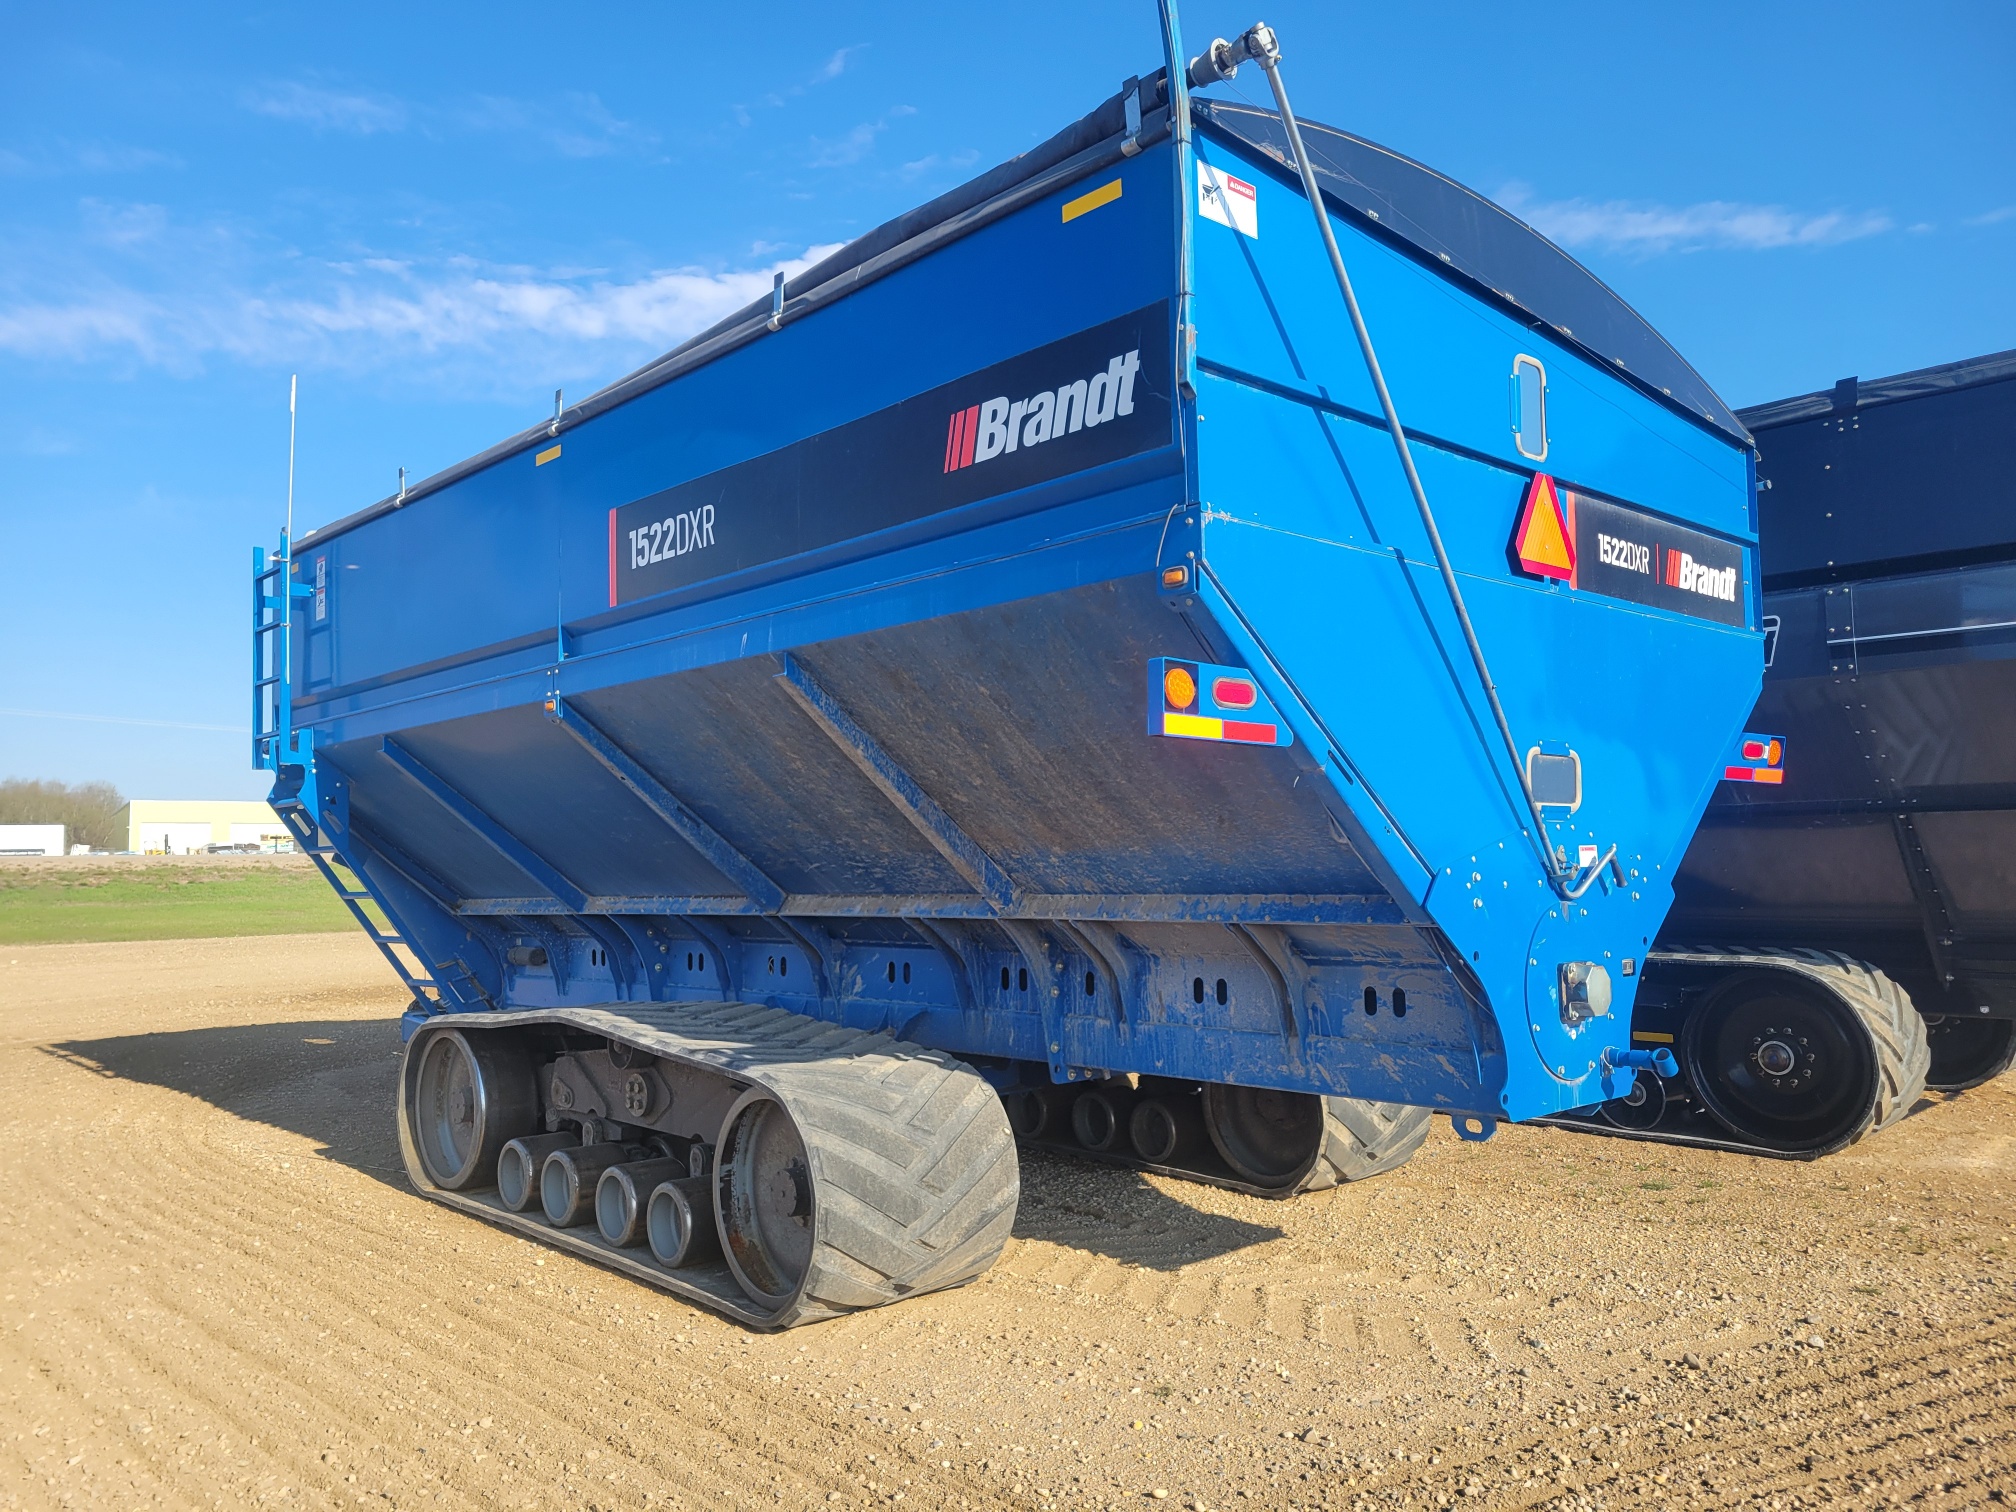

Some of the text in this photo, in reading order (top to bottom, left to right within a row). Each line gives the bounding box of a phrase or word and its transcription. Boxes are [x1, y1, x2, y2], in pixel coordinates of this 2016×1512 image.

[1234, 182, 1254, 198] DANGER
[974, 349, 1140, 464] Brandt
[629, 504, 715, 570] 1522DXR
[1598, 533, 1649, 575] 1522DXR
[1679, 552, 1736, 602] Brandt
